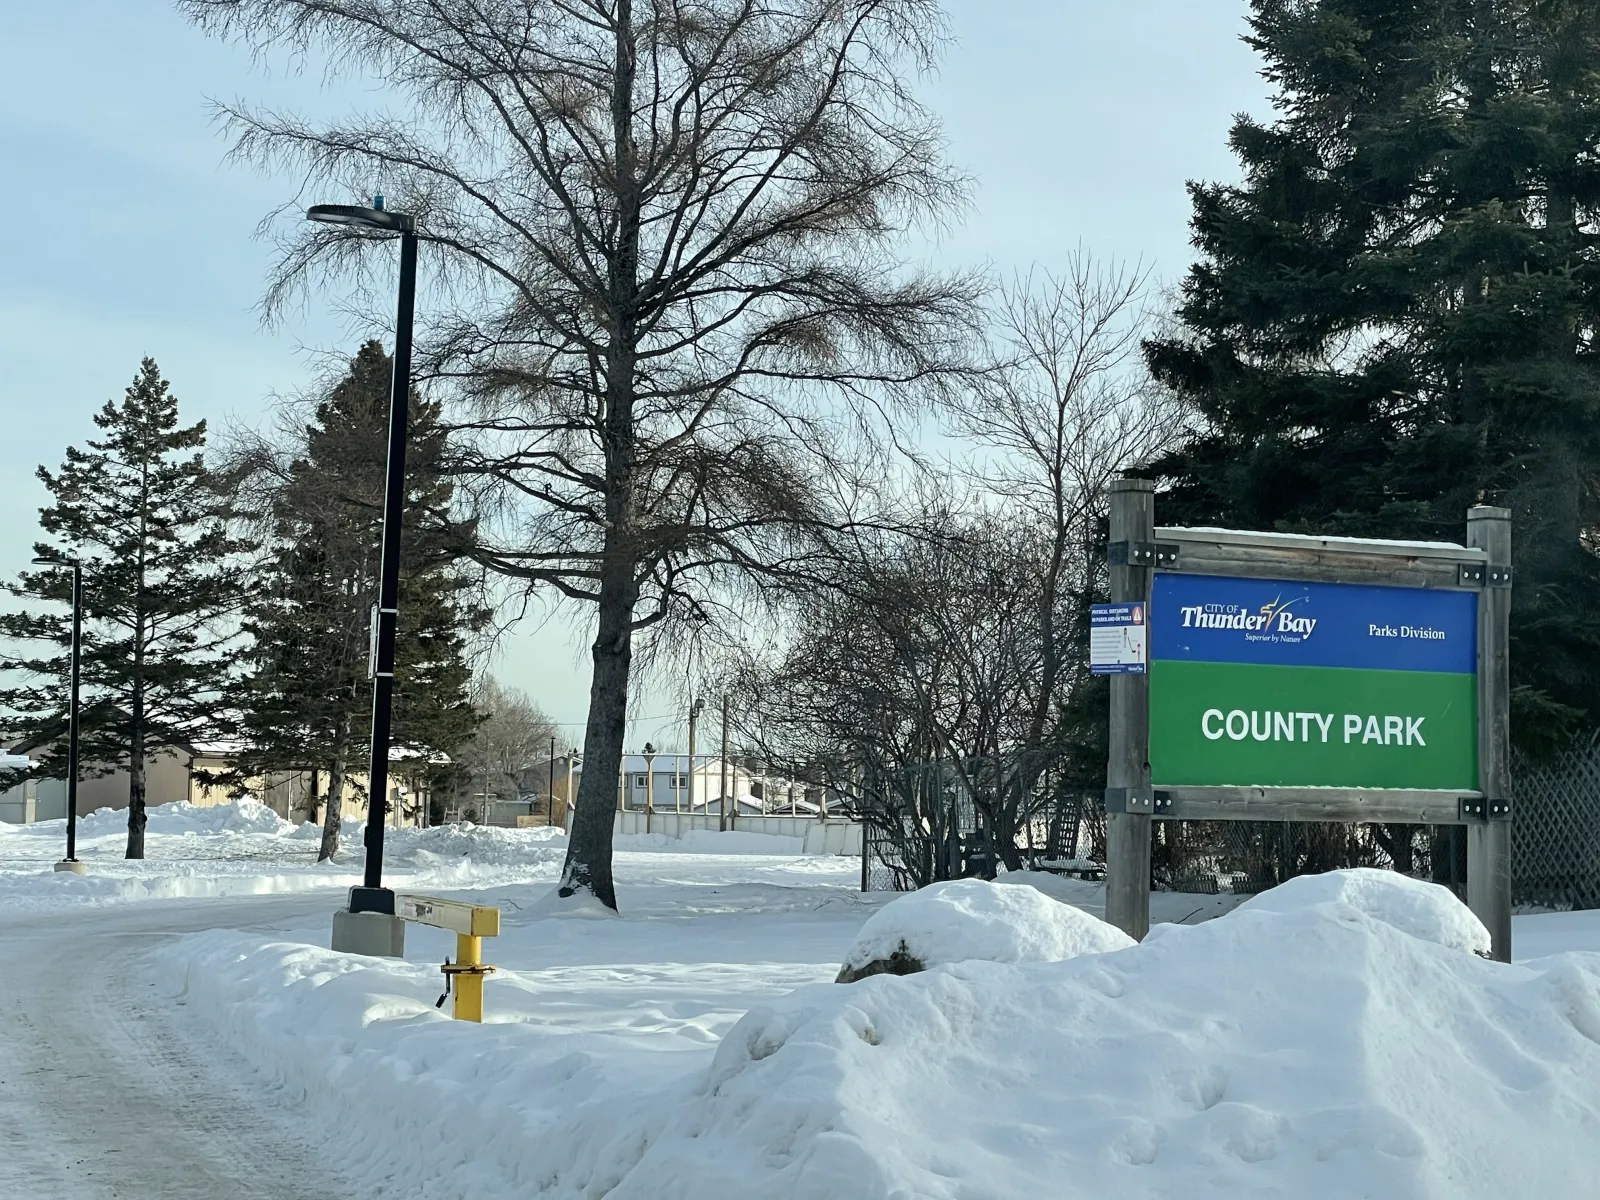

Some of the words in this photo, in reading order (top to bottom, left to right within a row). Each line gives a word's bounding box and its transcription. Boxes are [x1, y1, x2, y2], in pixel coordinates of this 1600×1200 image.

[1205, 604, 1225, 613] CITY
[1226, 605, 1239, 613] OF
[1181, 606, 1266, 630] Thunder
[1277, 612, 1316, 639] Bay
[1245, 633, 1271, 642] Superior
[1272, 634, 1279, 643] by
[1369, 624, 1398, 637] Parks
[1401, 625, 1445, 639] Division
[1202, 708, 1335, 743] COUNTY
[1344, 714, 1427, 746] PARK
